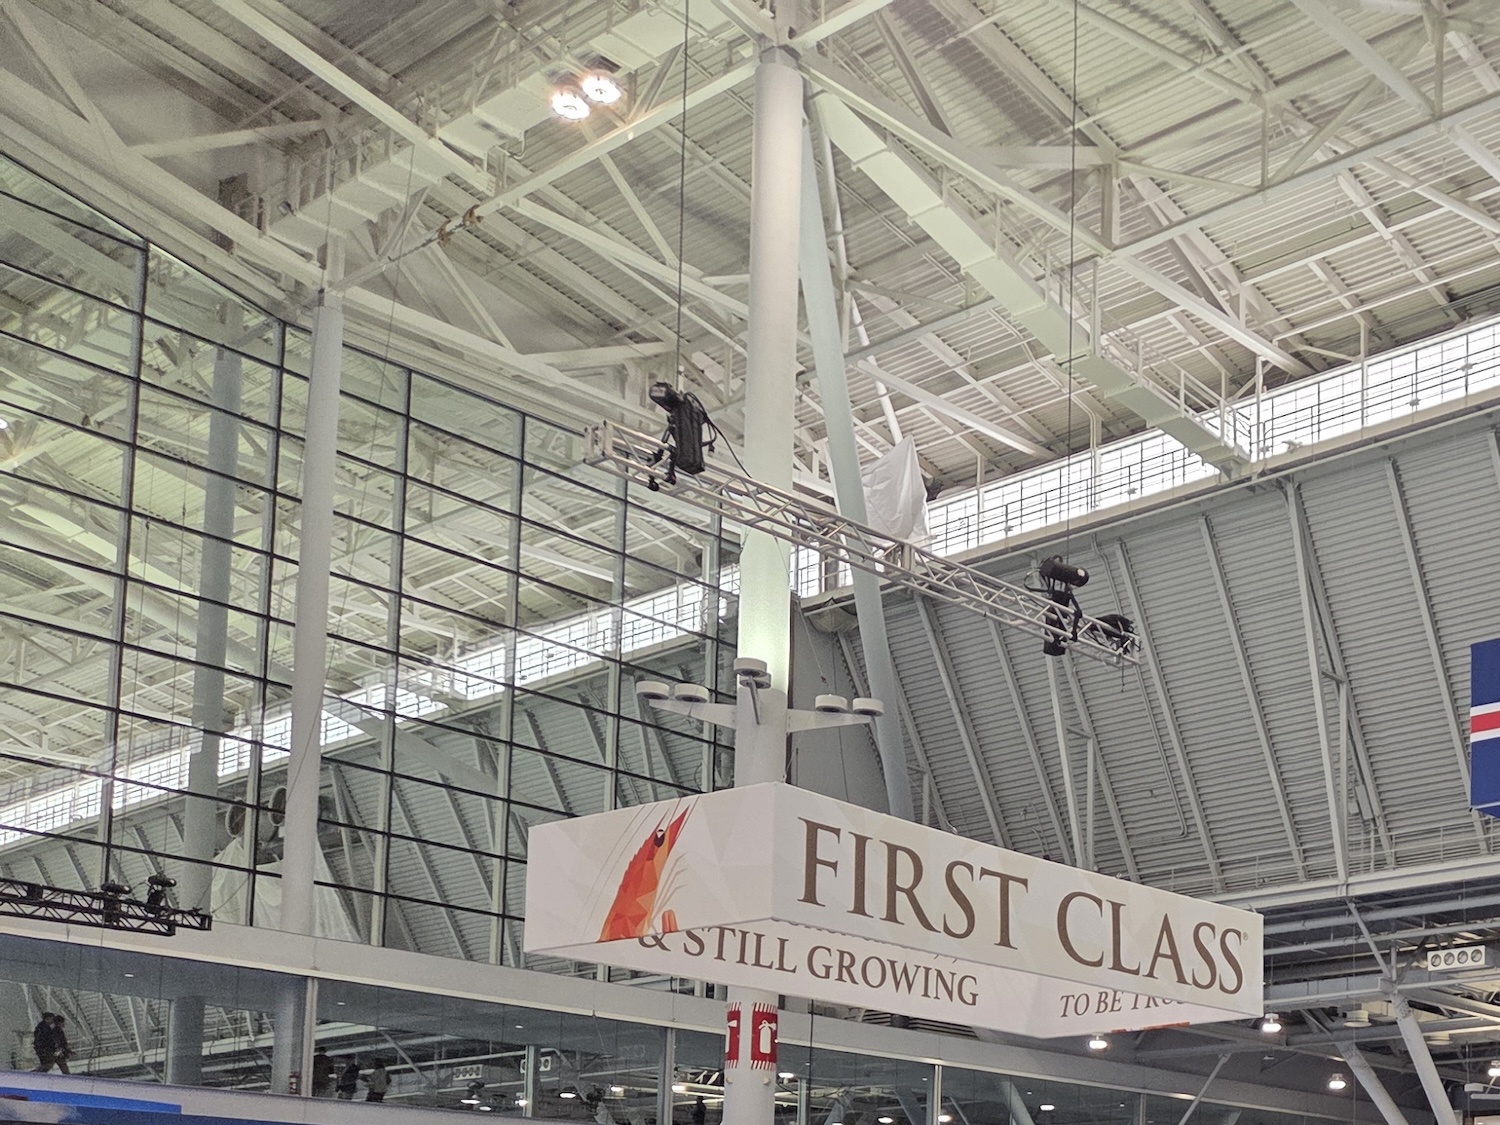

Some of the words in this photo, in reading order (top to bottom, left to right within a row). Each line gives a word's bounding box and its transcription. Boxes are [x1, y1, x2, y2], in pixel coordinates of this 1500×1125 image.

[797, 816, 1029, 950] FIRST
[683, 927, 797, 974] STILL
[806, 945, 979, 1006] GROWING
[1060, 993, 1090, 1017] TO
[1095, 989, 1124, 1014] BE
